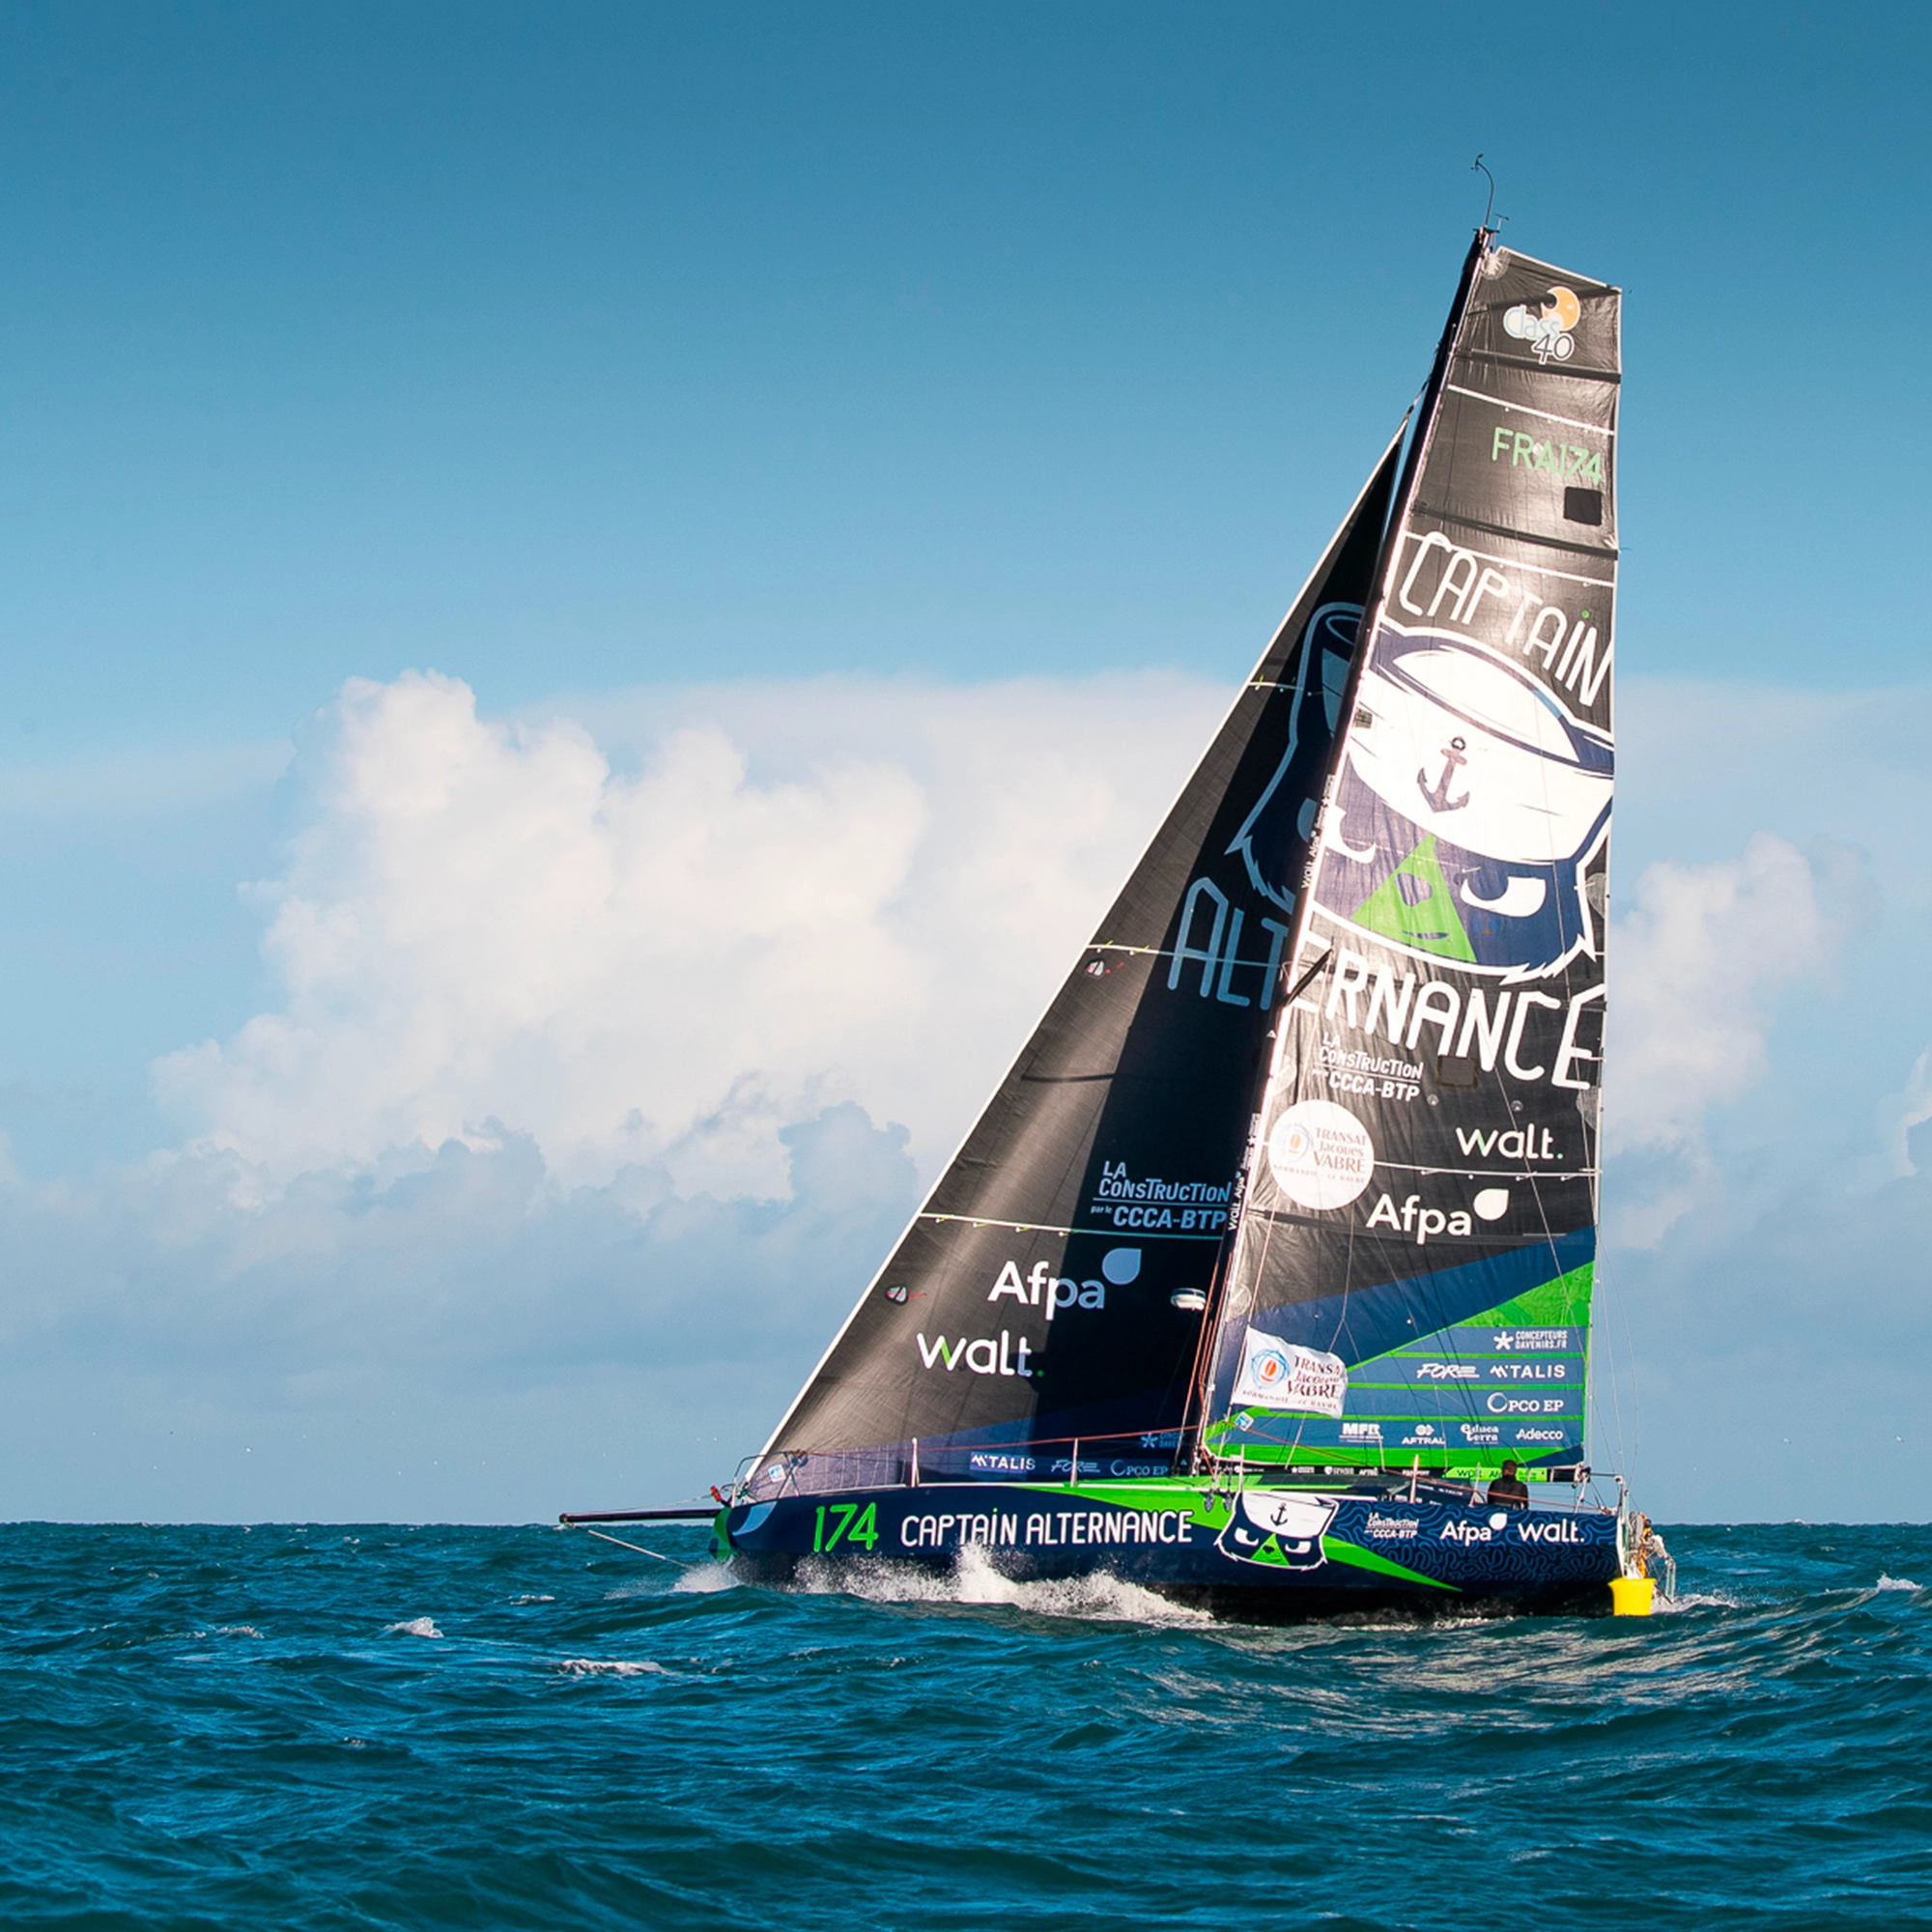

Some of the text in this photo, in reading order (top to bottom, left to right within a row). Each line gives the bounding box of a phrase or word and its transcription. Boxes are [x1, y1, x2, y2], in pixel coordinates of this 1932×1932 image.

[1503, 303, 1561, 341] Class
[1531, 333, 1574, 364] 40
[1492, 427, 1603, 486] FRA174
[1322, 1032, 1341, 1047] LA
[1328, 1070, 1420, 1102] CCCA-BTP
[1316, 1127, 1366, 1146] TRANSAT
[1103, 1160, 1126, 1179] LA
[1314, 1151, 1366, 1173] VABRE
[1113, 1206, 1227, 1230] CCCA-BTP
[1365, 1193, 1472, 1245] Afpa
[987, 1260, 1106, 1321] Afpa
[917, 1330, 1044, 1378] walt.
[1544, 1400, 1564, 1411] EP
[1516, 1428, 1564, 1440] Adecco
[1152, 1465, 1168, 1475] EP
[813, 1502, 878, 1552] 174
[1025, 1511, 1193, 1546] ALTERNANCE
[1439, 1520, 1492, 1547] Afpa
[1518, 1519, 1585, 1543] walt.
